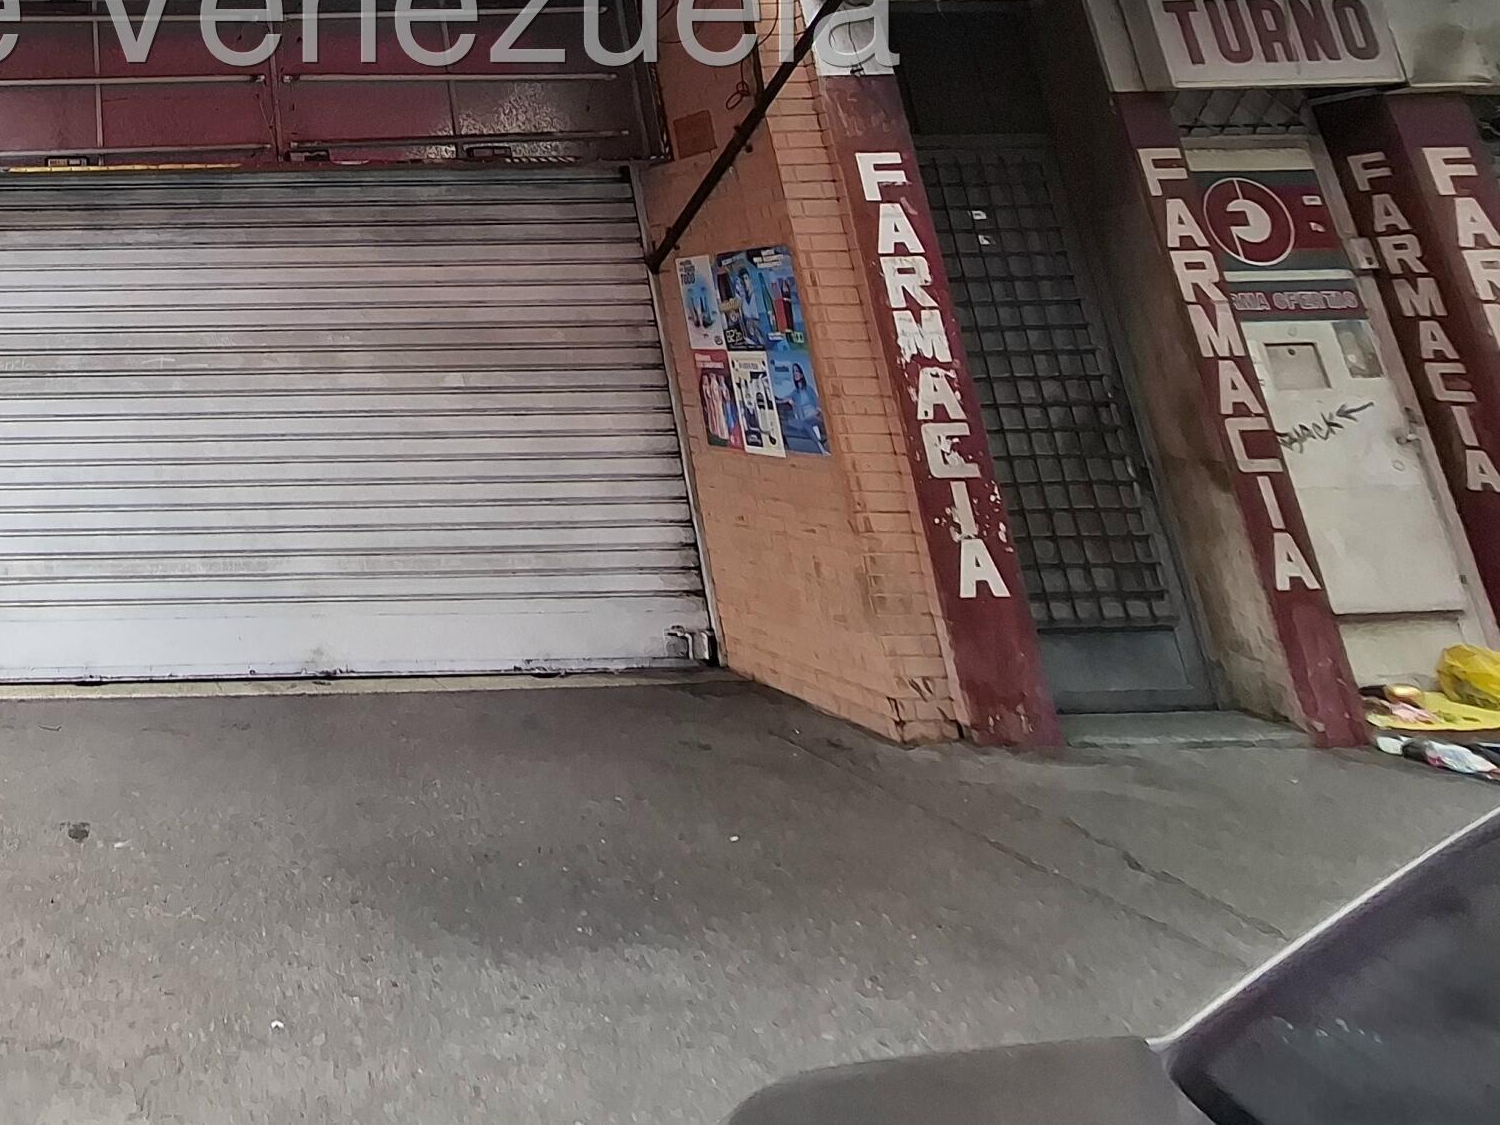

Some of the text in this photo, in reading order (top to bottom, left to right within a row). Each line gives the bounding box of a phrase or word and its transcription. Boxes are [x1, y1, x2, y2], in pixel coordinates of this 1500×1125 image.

[854, 151, 1011, 598] FARMACIA
[1137, 148, 1321, 592] FARMACIA
[1346, 152, 1500, 492] FARMACIA
